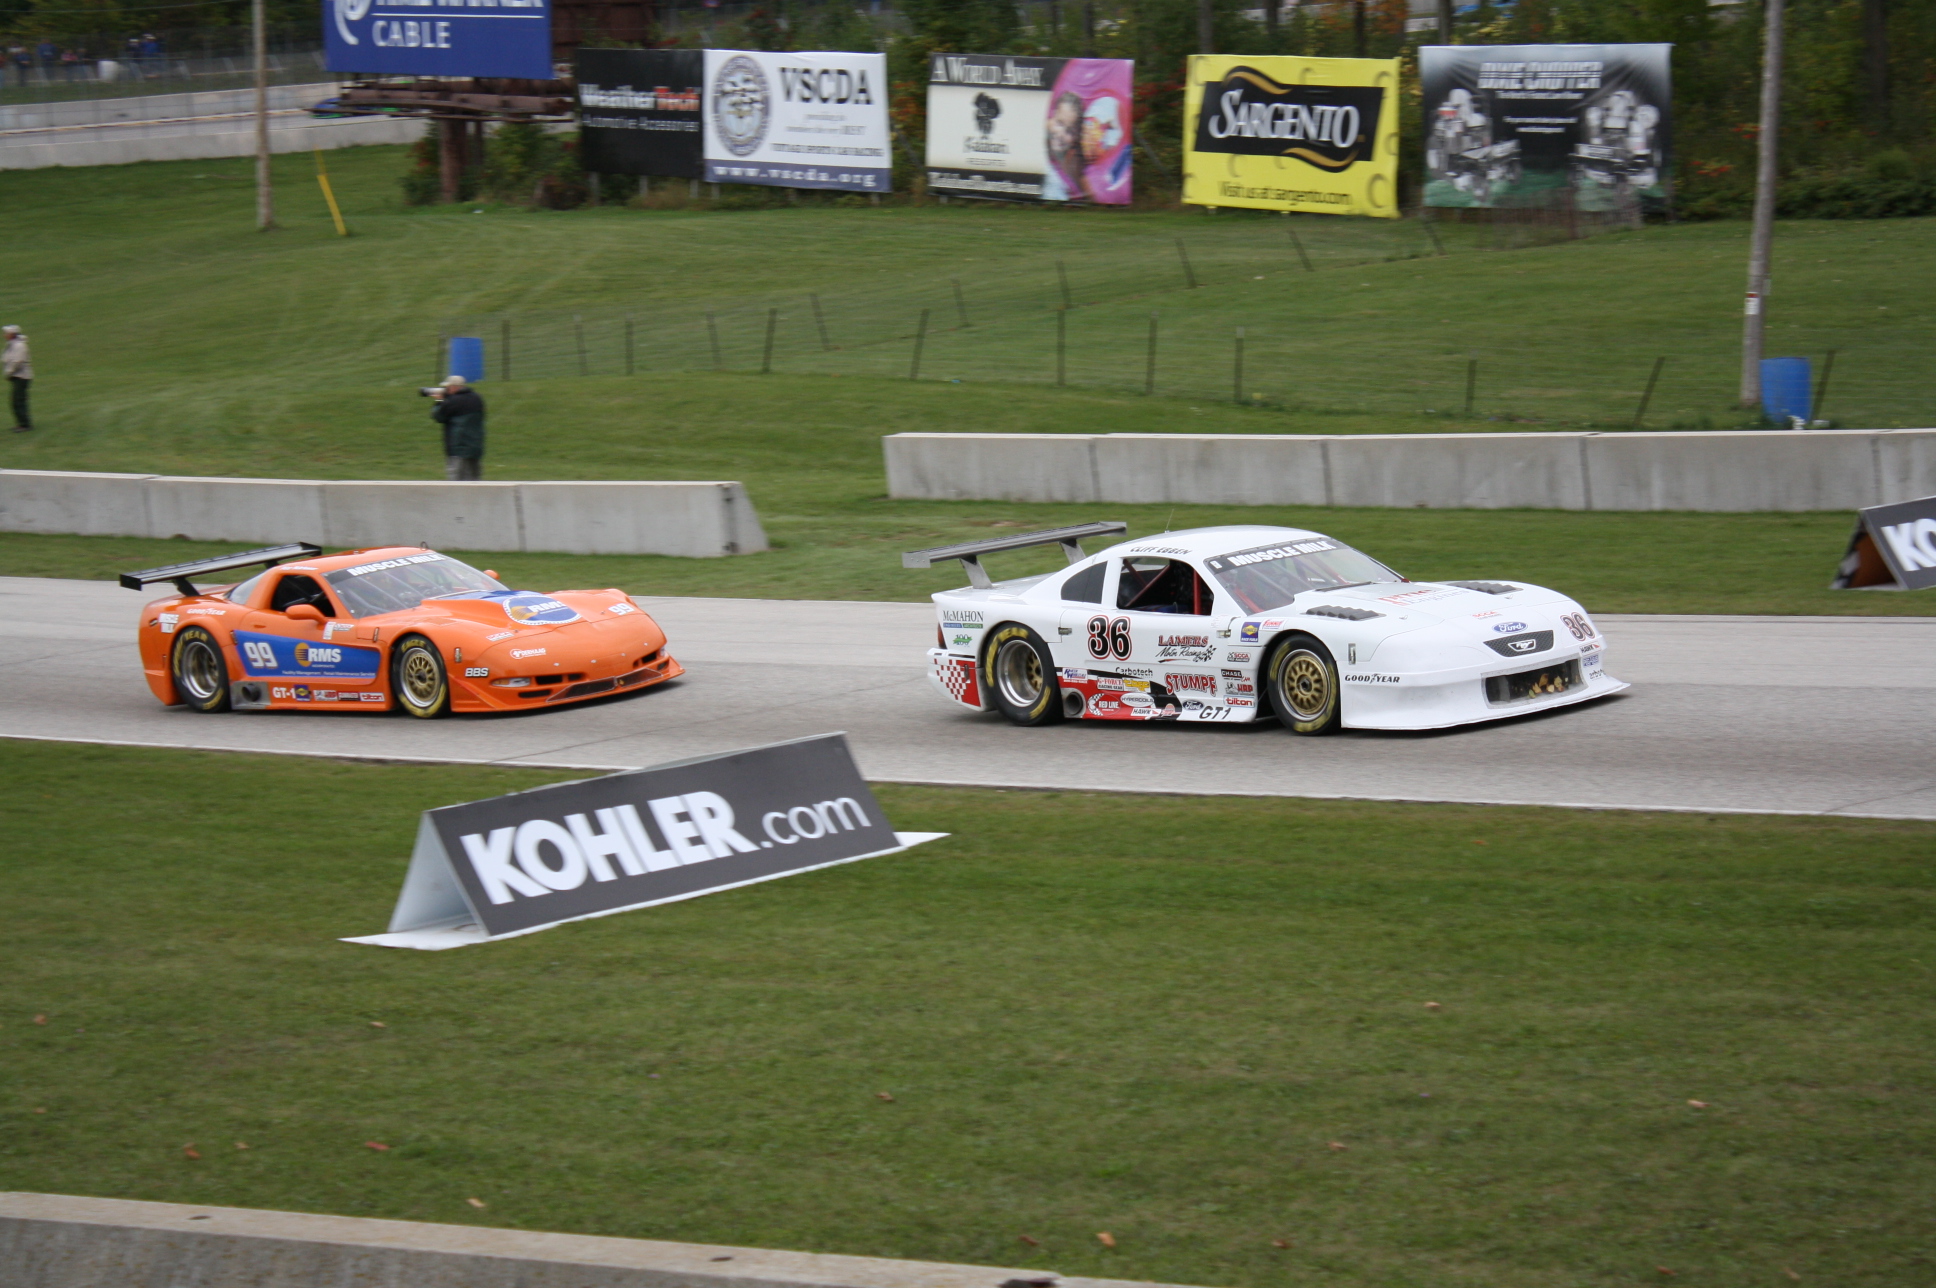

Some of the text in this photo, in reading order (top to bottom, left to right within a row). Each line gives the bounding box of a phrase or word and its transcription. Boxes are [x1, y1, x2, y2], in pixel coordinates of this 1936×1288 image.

[372, 20, 451, 48] CABLE
[930, 56, 949, 82] A
[777, 66, 873, 105] VSCDA
[1208, 88, 1360, 148] SARGENTO
[712, 166, 877, 187] www.vscda.org
[346, 553, 446, 577] MUSCLE MILK
[1227, 541, 1337, 567] MUSCLE MILK
[608, 603, 635, 616] 99
[943, 610, 984, 622] McMAHON
[1087, 614, 1132, 661] 36
[1501, 624, 1524, 632] Ford
[1560, 612, 1596, 641] 36
[1158, 635, 1209, 647] LAMERS
[244, 642, 278, 669] 99
[308, 648, 341, 663] RMS
[465, 667, 489, 678] BBS
[1116, 667, 1153, 676] Carbotech
[1165, 672, 1217, 697] STUMPF
[1199, 706, 1231, 720] GT1
[1226, 698, 1252, 706] tilton
